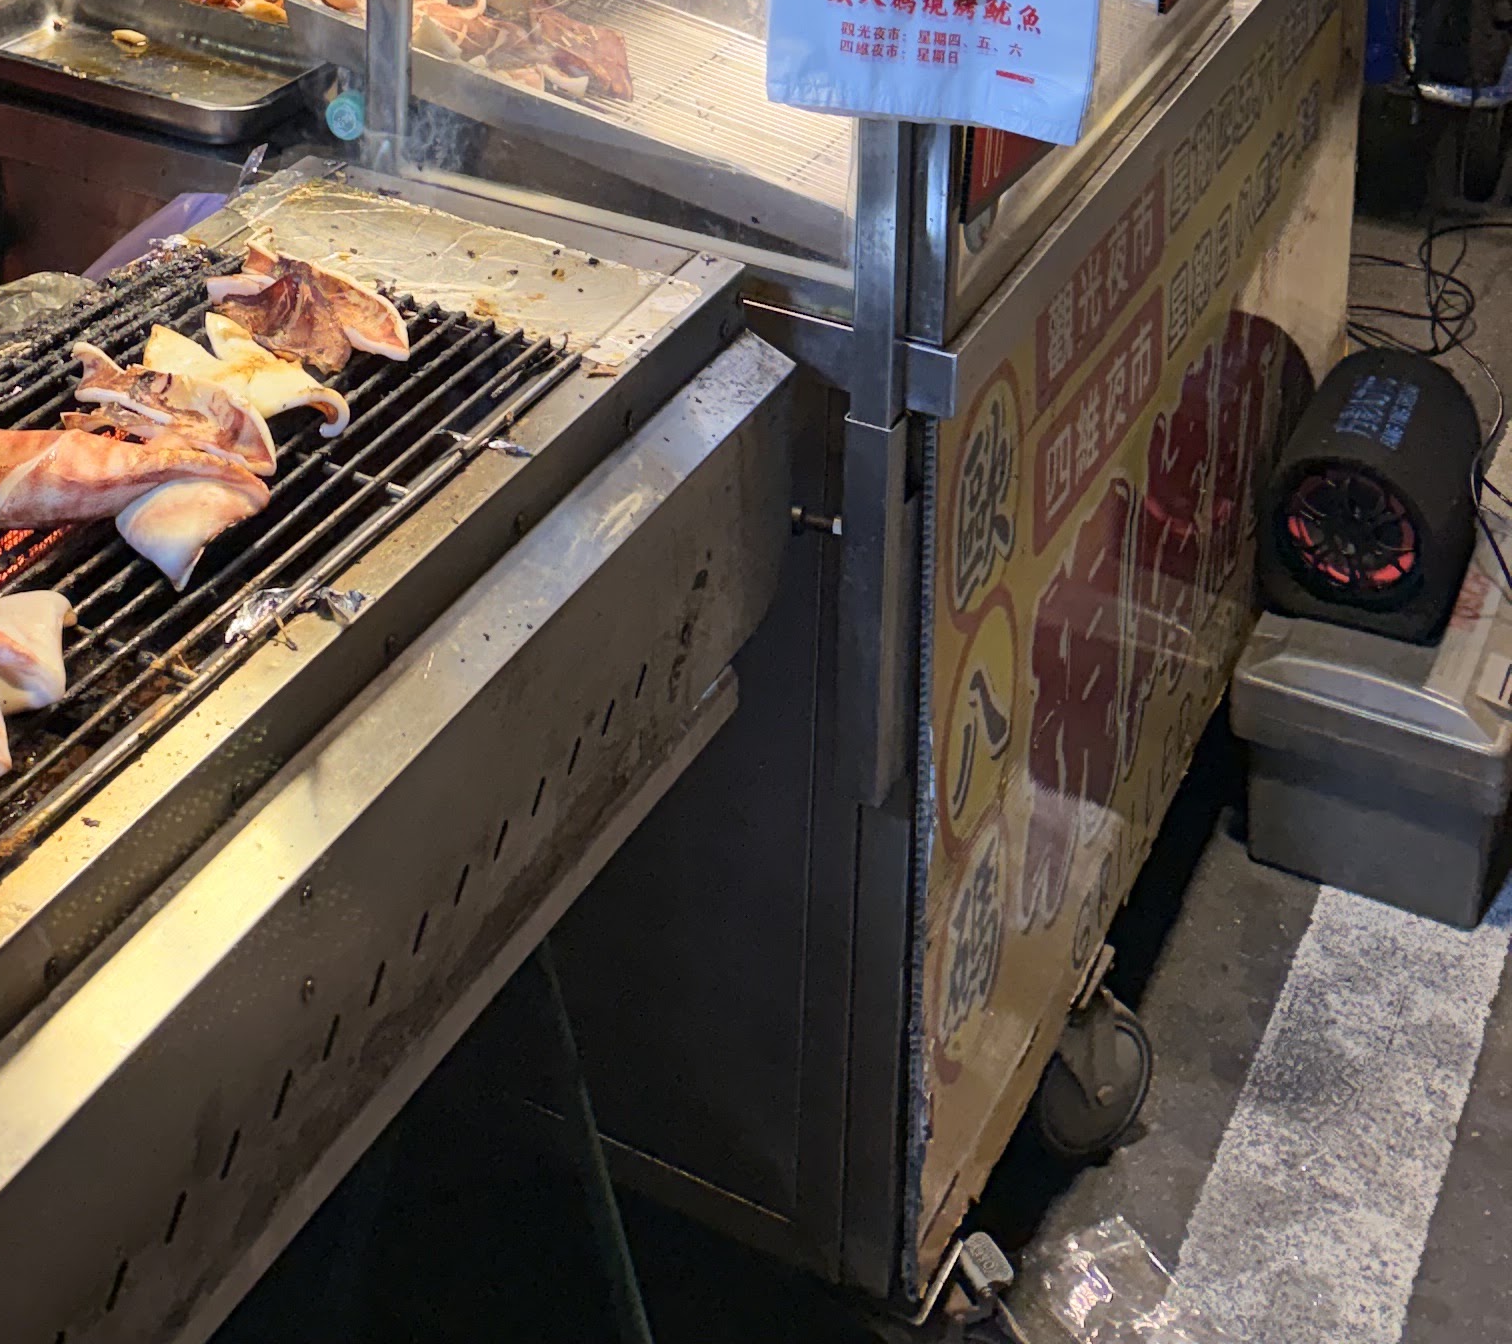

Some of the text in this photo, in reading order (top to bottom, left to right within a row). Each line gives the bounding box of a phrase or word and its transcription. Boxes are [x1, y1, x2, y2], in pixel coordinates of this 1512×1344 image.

[1046, 190, 1156, 382] 觀光夜市
[1043, 319, 1155, 516] 四維夜市
